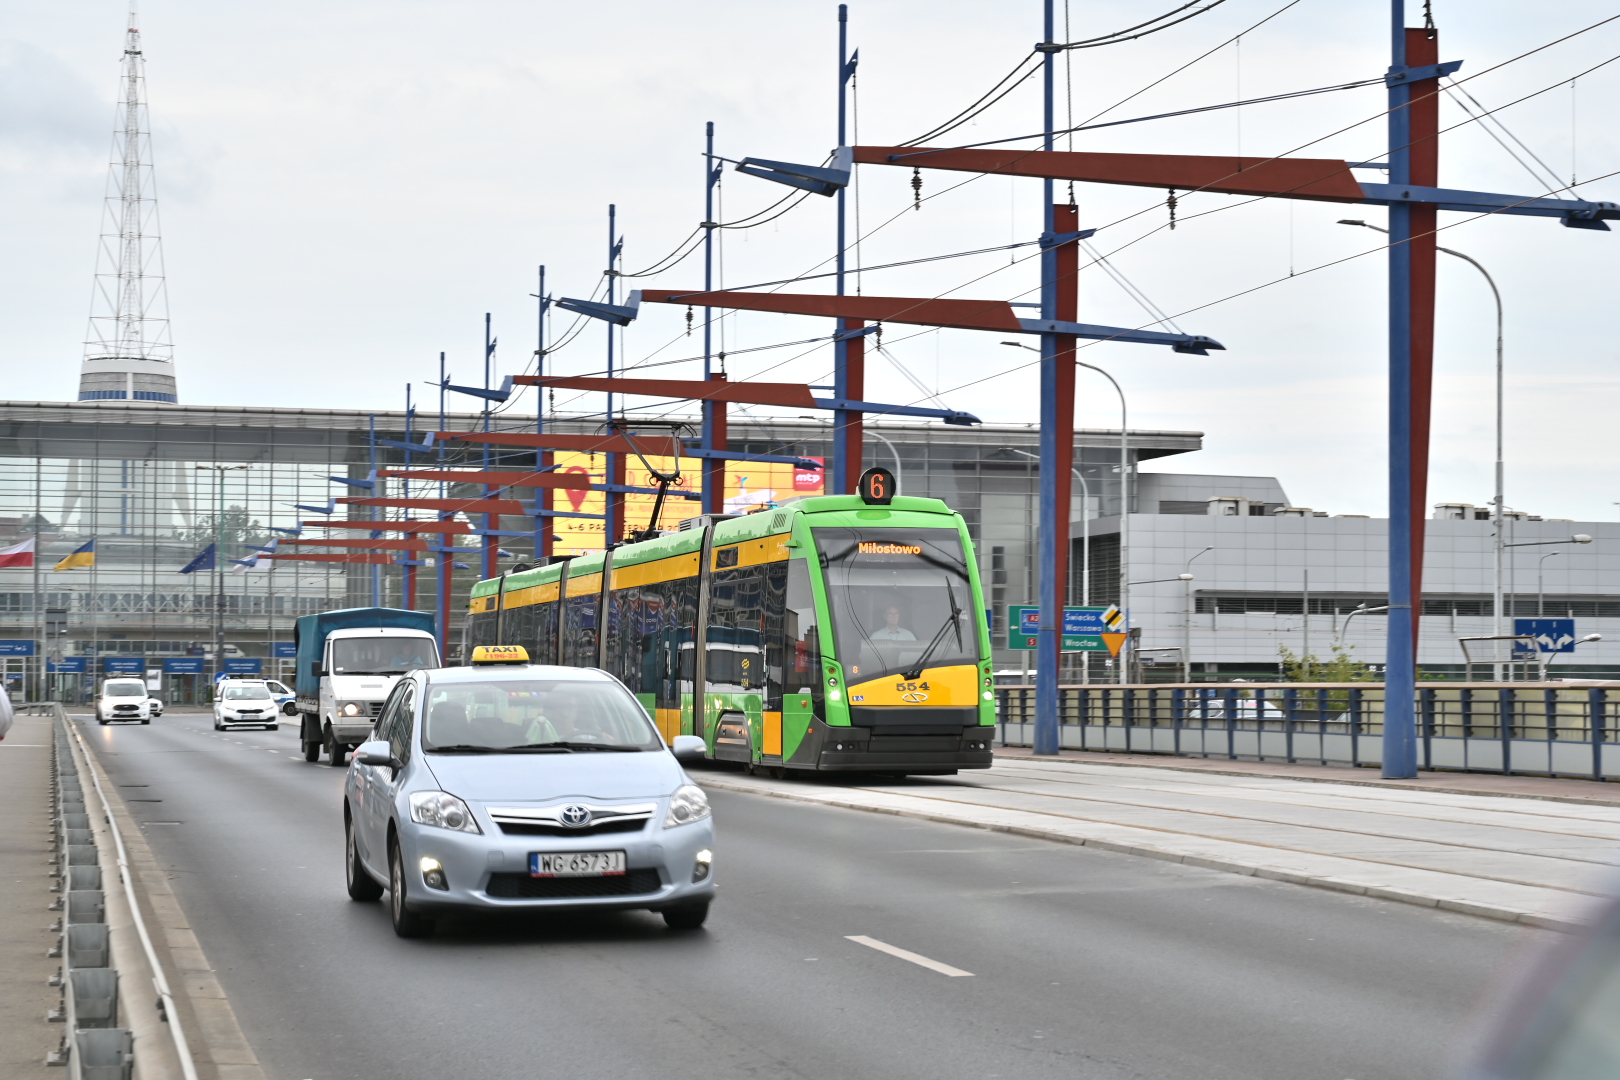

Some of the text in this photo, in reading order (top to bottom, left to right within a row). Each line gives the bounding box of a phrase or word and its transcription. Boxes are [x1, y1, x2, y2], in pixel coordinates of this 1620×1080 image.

[795, 473, 821, 484] mtp
[870, 474, 885, 499] 6
[858, 542, 922, 555] Miłostowo
[1064, 612, 1097, 622] Świecko
[1064, 623, 1103, 632] Warszawa
[1064, 638, 1099, 647] Wrocław
[852, 665, 859, 674] 8
[896, 681, 931, 692] 554
[542, 852, 620, 873] WG 6573J
